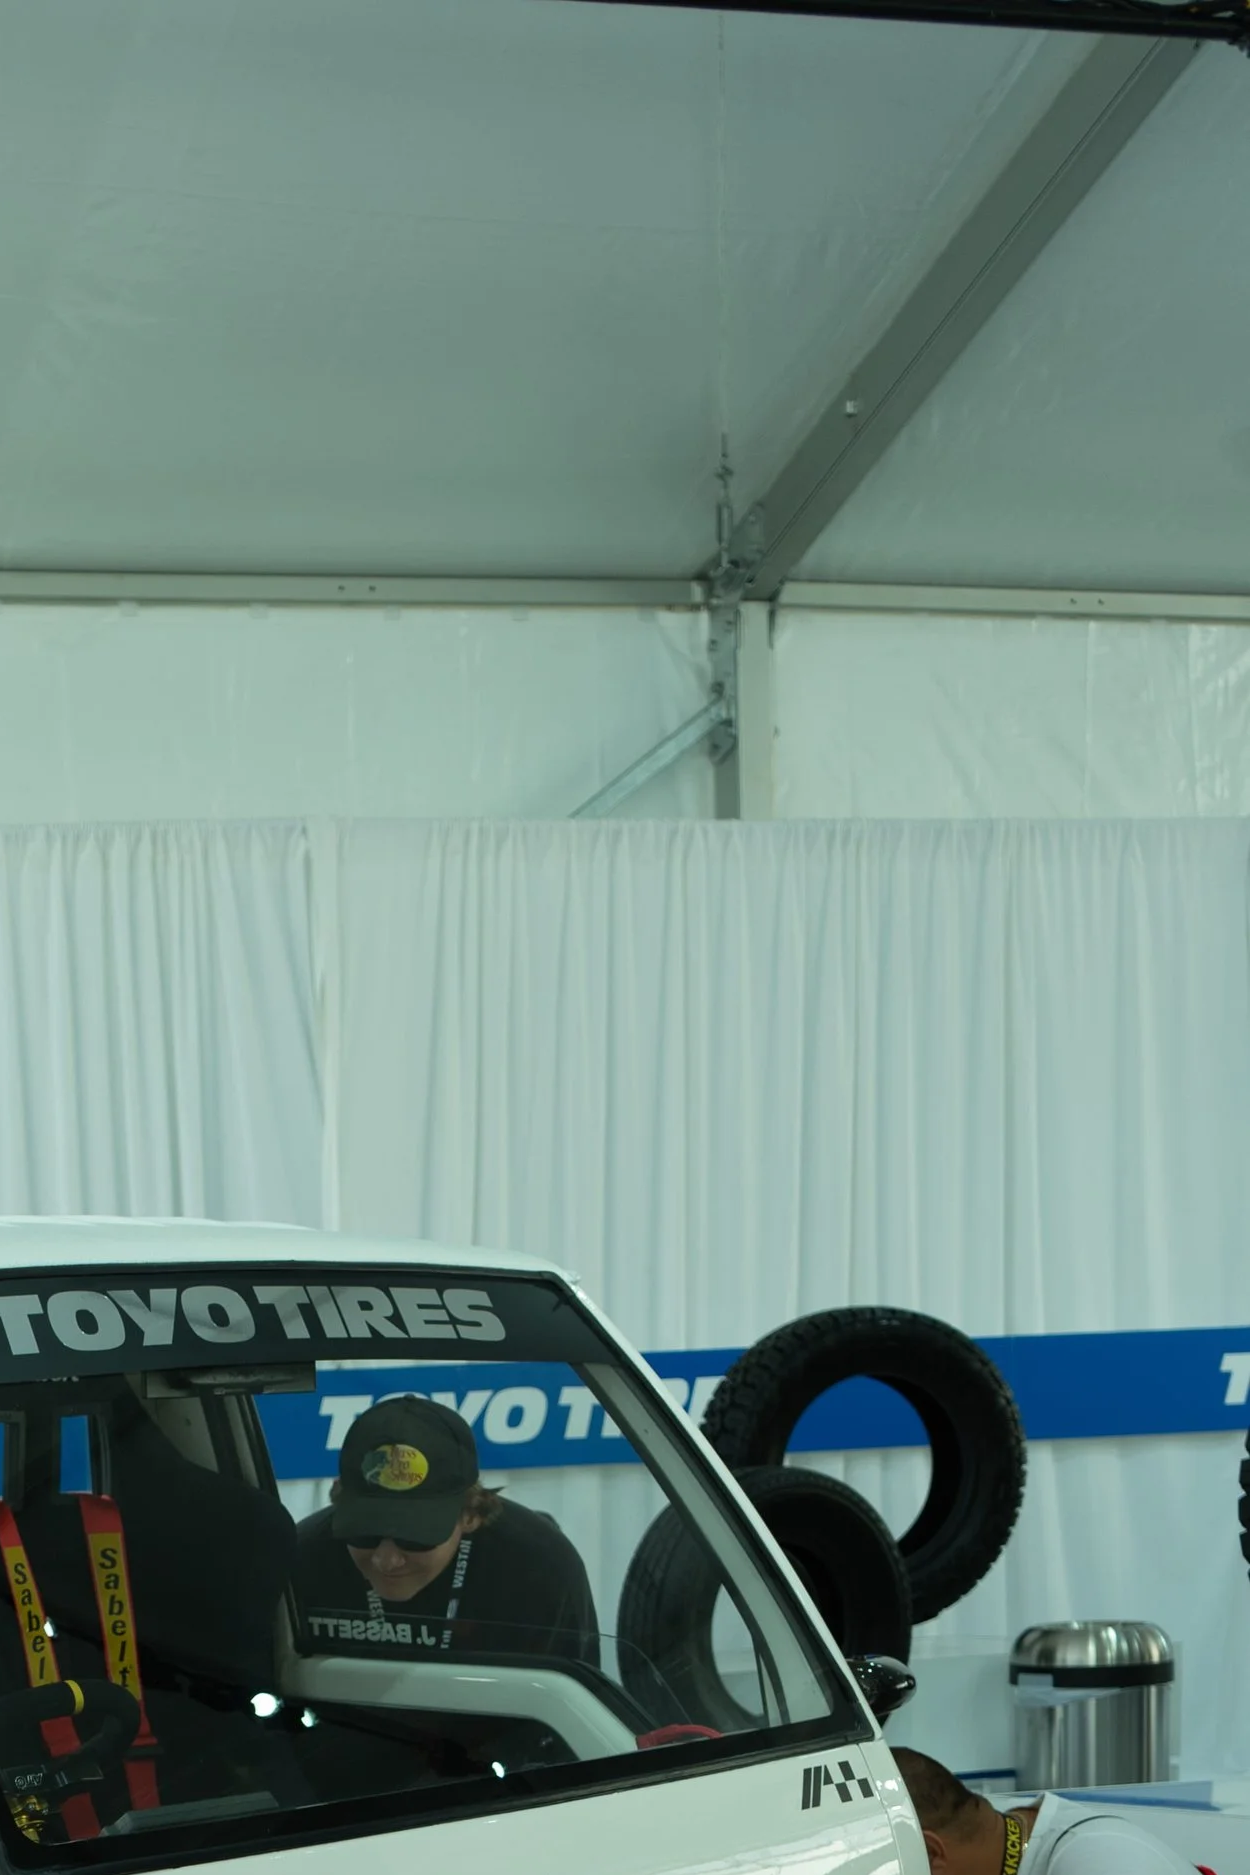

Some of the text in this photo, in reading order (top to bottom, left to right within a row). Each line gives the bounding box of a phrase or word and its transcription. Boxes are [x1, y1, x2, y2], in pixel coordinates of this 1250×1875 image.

[254, 1285, 507, 1343] TIRES
[12, 1561, 47, 1682] Sabel
[99, 1546, 134, 1690] Sabelt
